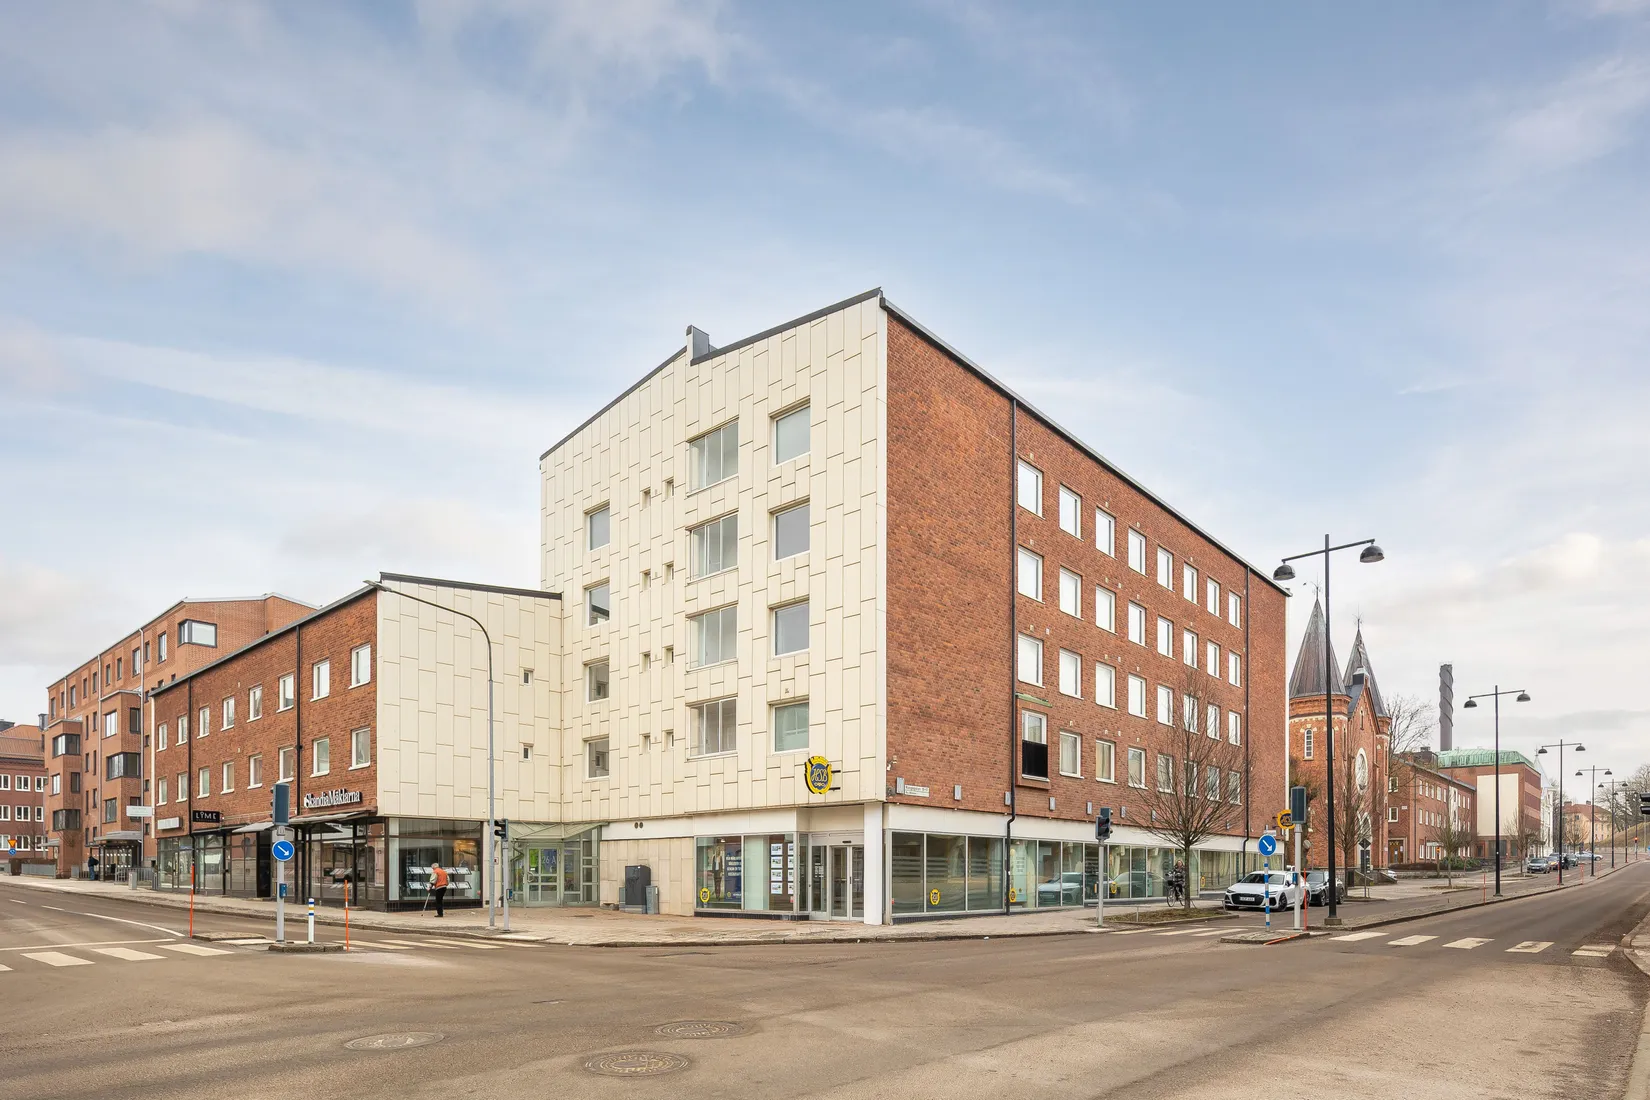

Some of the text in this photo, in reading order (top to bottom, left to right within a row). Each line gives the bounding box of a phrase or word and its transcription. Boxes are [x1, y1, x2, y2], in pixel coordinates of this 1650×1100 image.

[811, 768, 828, 782] HSB
[304, 788, 361, 808] SkandiaMäklarna
[542, 855, 557, 864] 26 A
